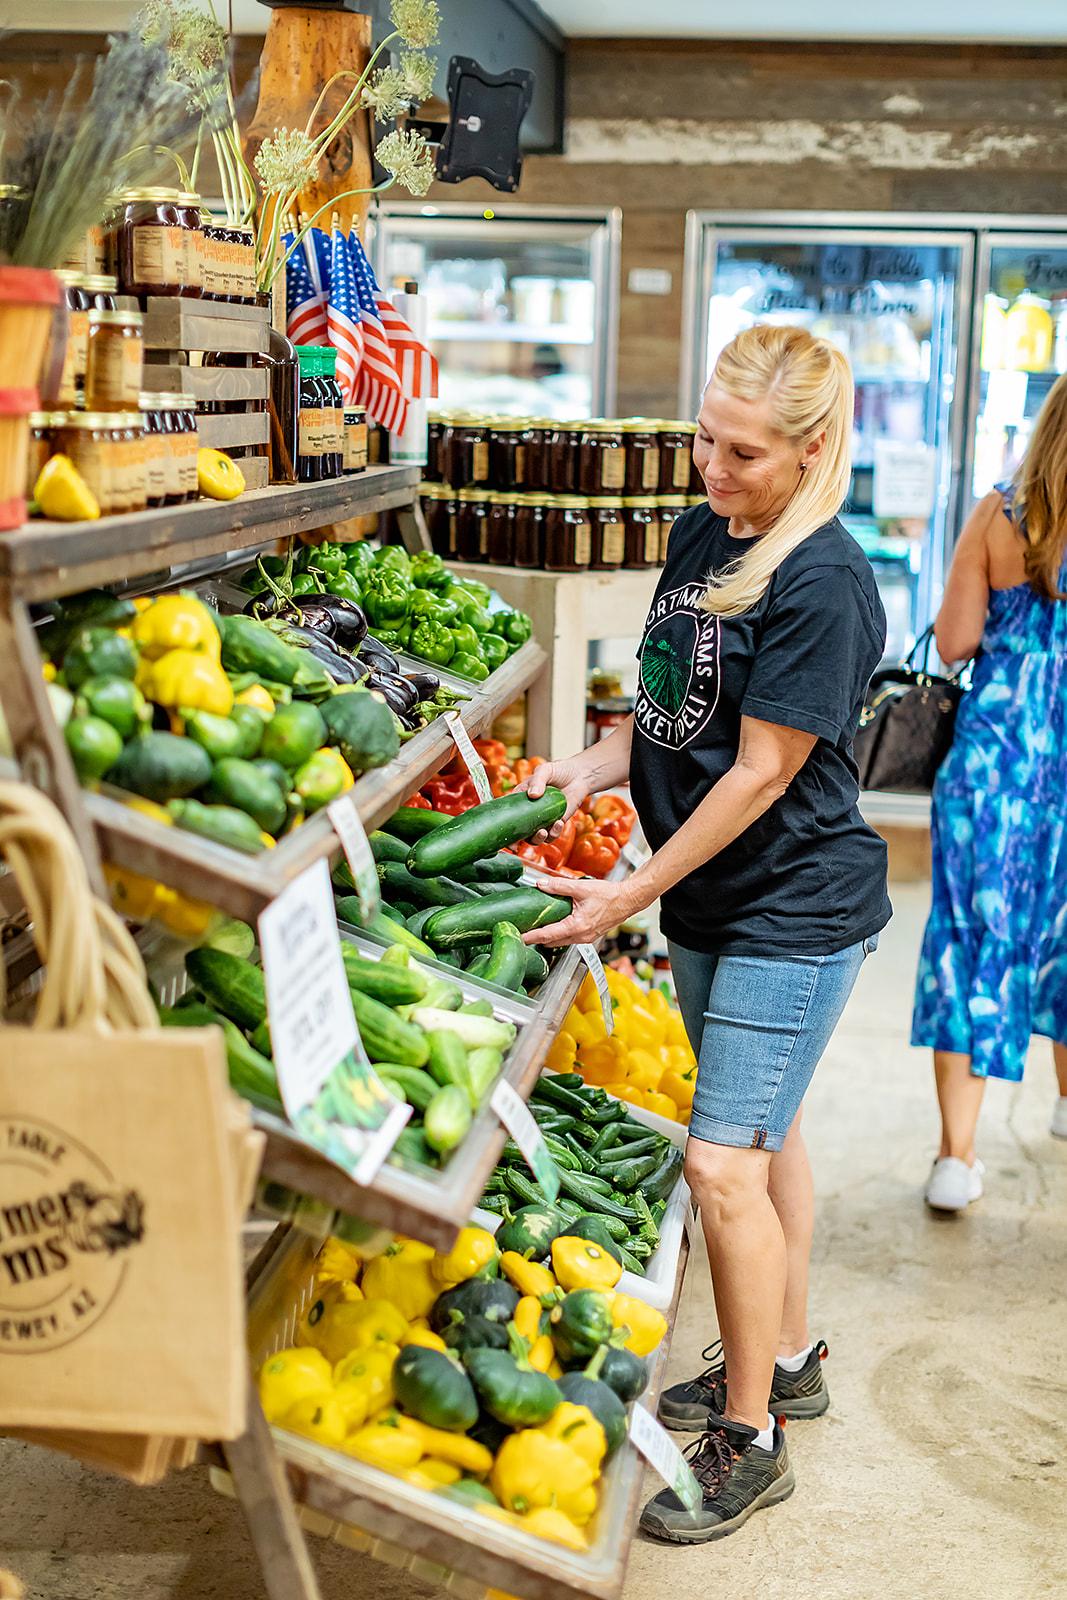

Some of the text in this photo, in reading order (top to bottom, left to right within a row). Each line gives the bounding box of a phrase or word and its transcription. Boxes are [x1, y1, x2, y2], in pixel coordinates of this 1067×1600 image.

[644, 587, 715, 678] ORTIM ARMS
[0, 1185, 82, 1240] mer
[0, 1234, 69, 1284] ms
